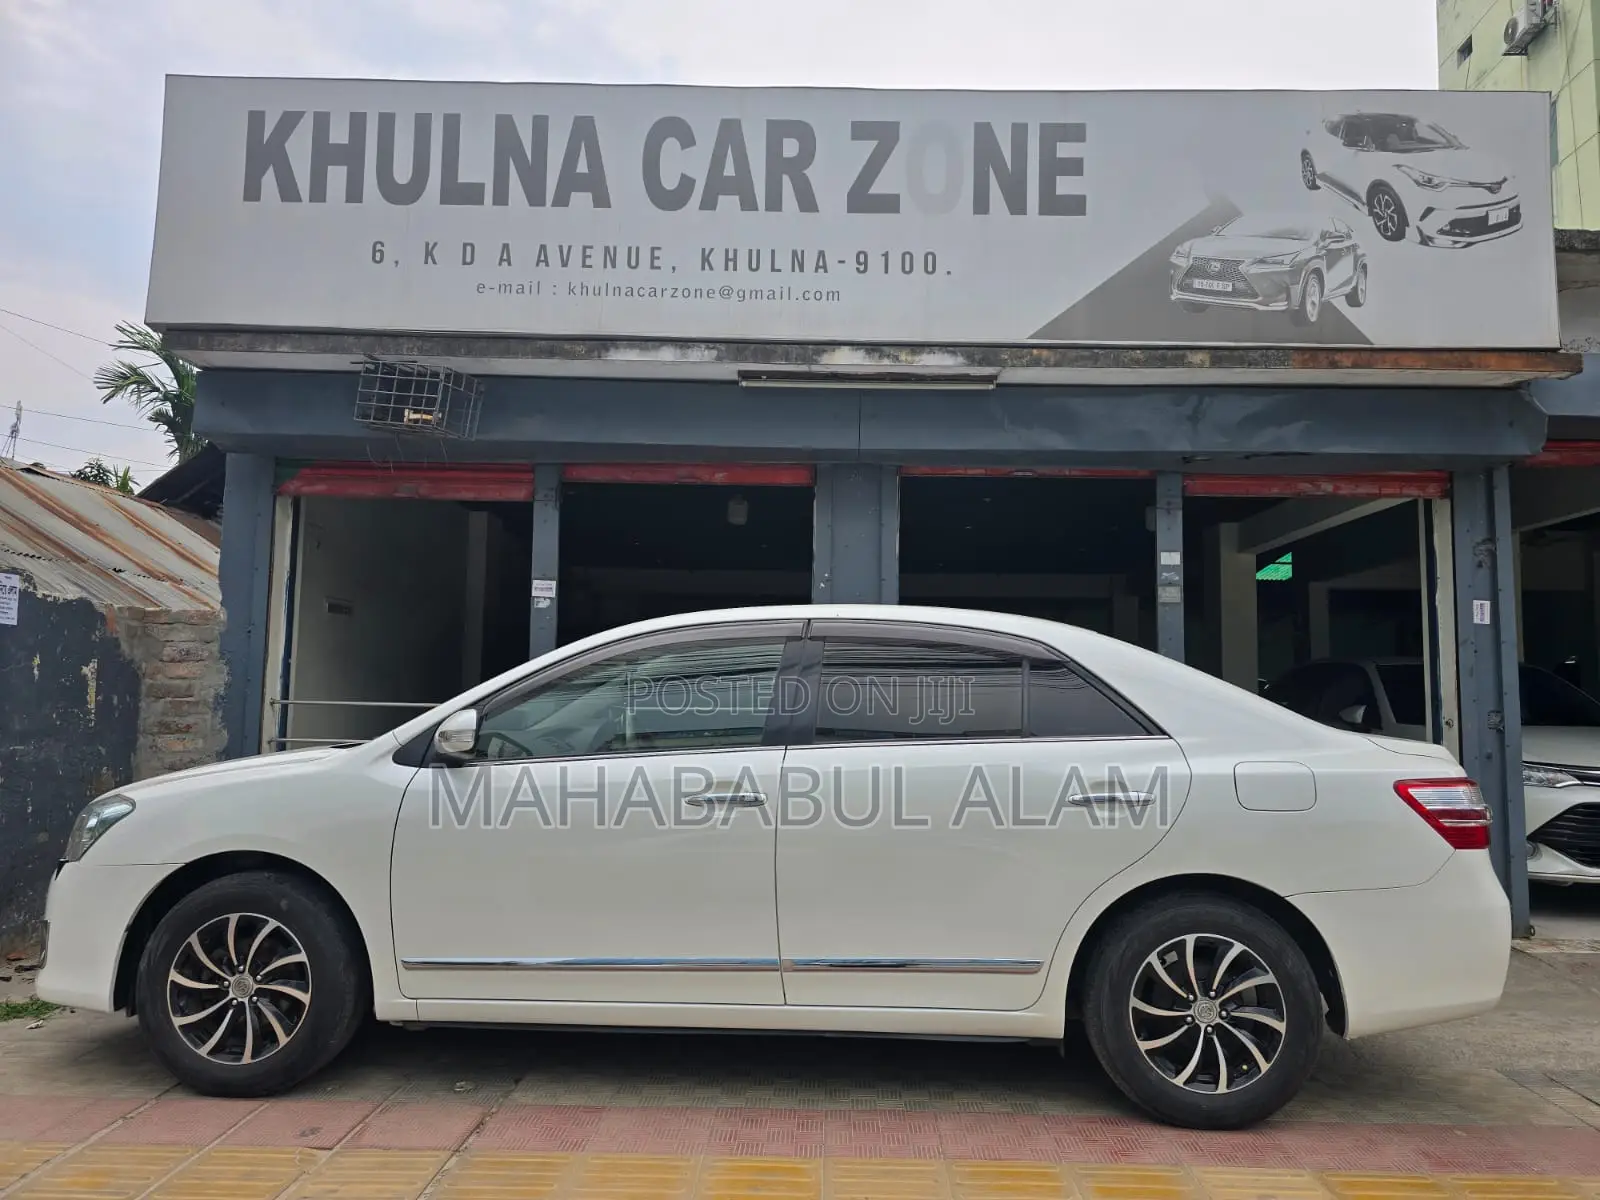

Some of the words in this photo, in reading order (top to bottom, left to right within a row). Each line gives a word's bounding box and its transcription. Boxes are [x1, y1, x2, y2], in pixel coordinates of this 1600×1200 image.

[242, 110, 612, 209] KHULNA
[642, 116, 819, 213] CAR
[847, 120, 1087, 216] ZONE
[371, 241, 400, 268] 6,
[423, 242, 437, 266] K
[461, 242, 475, 266] D
[498, 243, 512, 267] A
[535, 243, 677, 274] AVENUE,
[701, 247, 952, 276] KHULNA-9100.
[476, 279, 541, 296] e-mail
[567, 281, 841, 303] khulnacarzone@gmail.com
